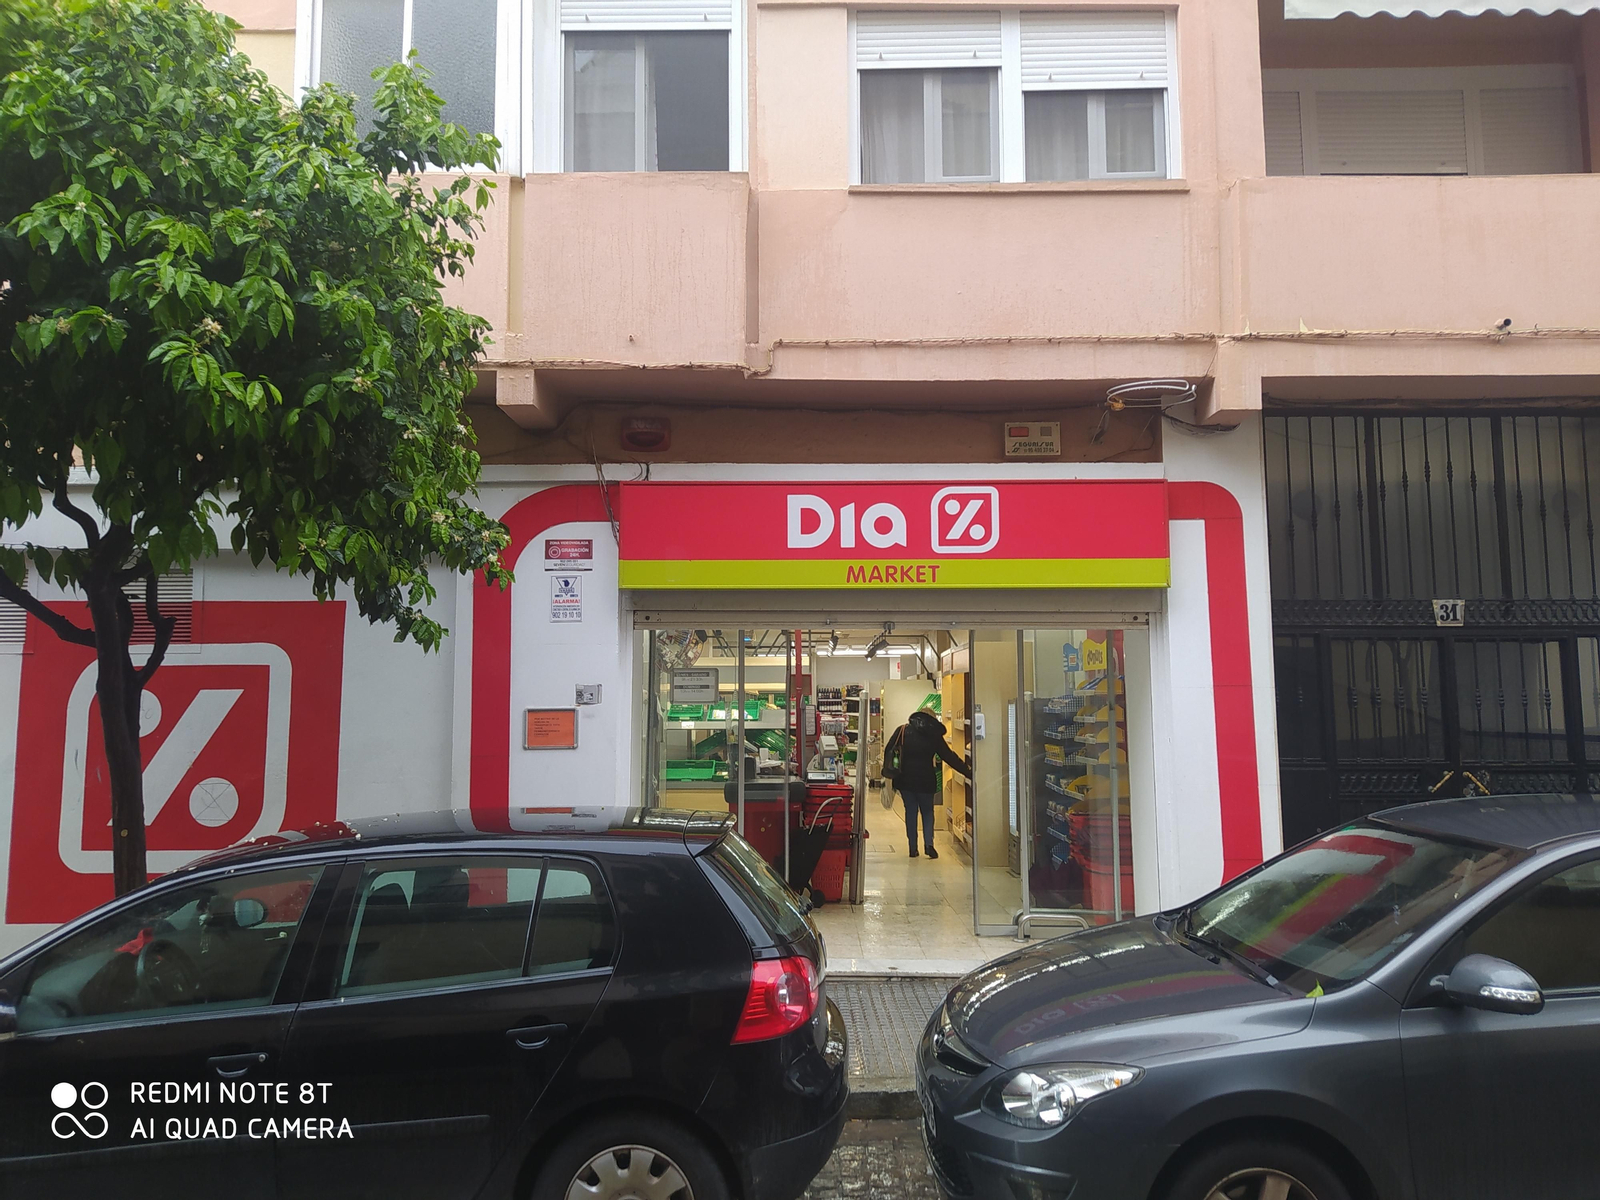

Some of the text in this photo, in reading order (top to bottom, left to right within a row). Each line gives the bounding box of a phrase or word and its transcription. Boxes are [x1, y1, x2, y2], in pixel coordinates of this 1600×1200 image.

[846, 565, 940, 584] MARKET
[552, 611, 561, 619] 902
[1439, 603, 1460, 622] 31
